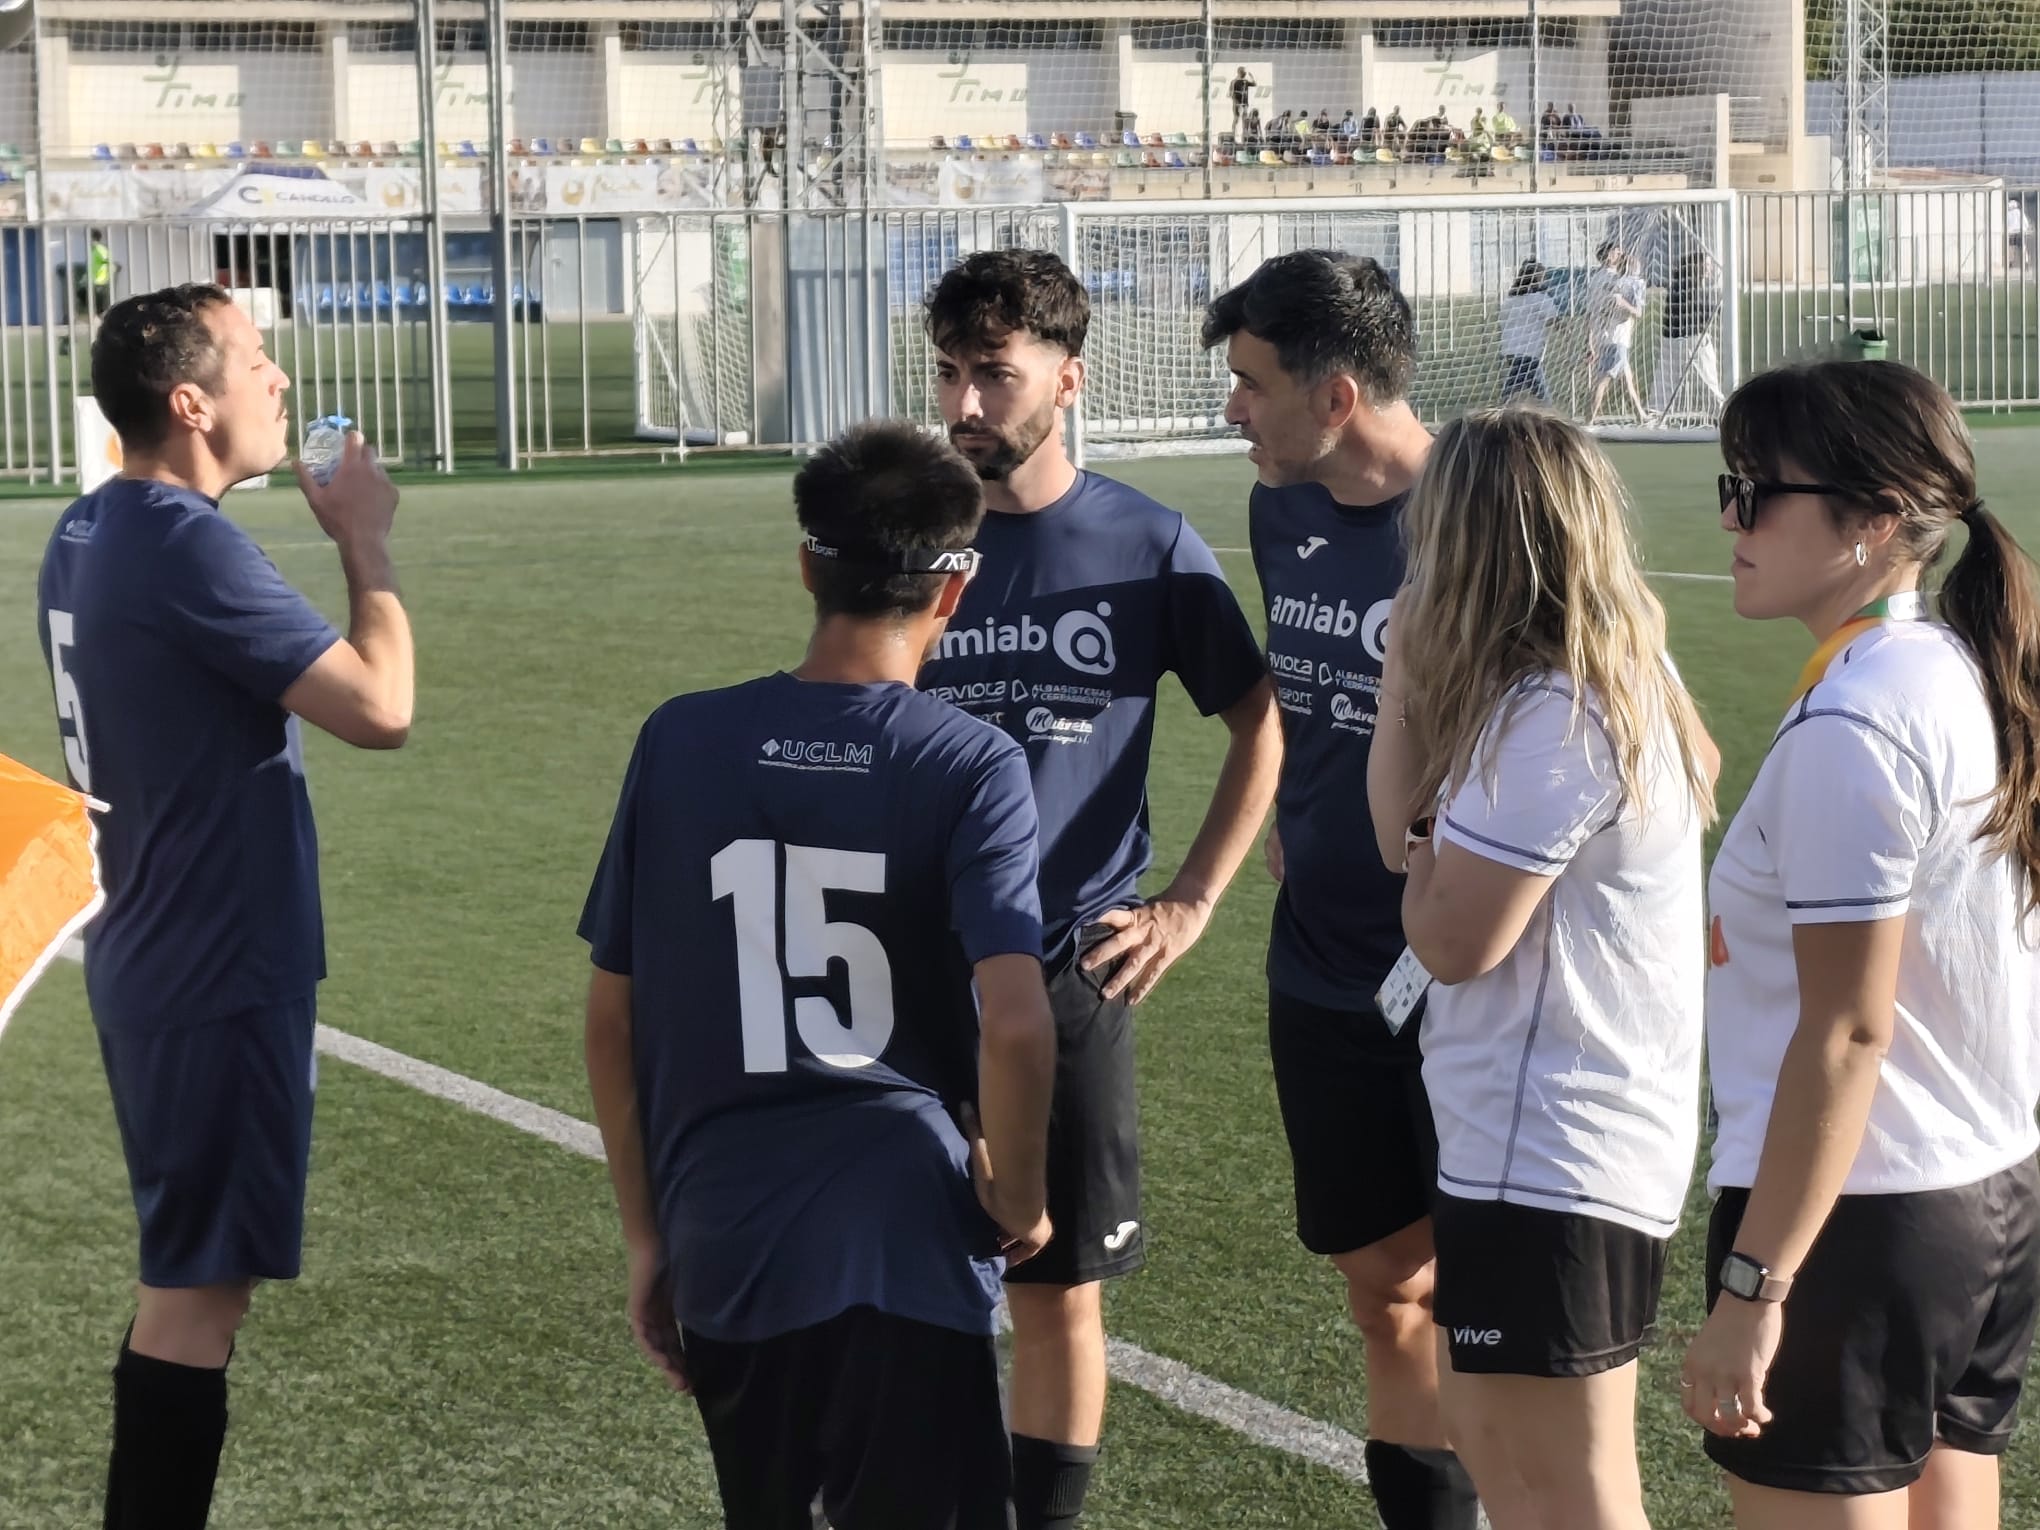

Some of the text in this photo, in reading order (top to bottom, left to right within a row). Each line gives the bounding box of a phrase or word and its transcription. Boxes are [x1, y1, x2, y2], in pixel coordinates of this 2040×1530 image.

[1270, 592, 1358, 638] amiab
[48, 608, 91, 794] 5
[782, 739, 873, 765] UCLM
[710, 838, 895, 1073] 15
[1453, 1325, 1502, 1345] vive
